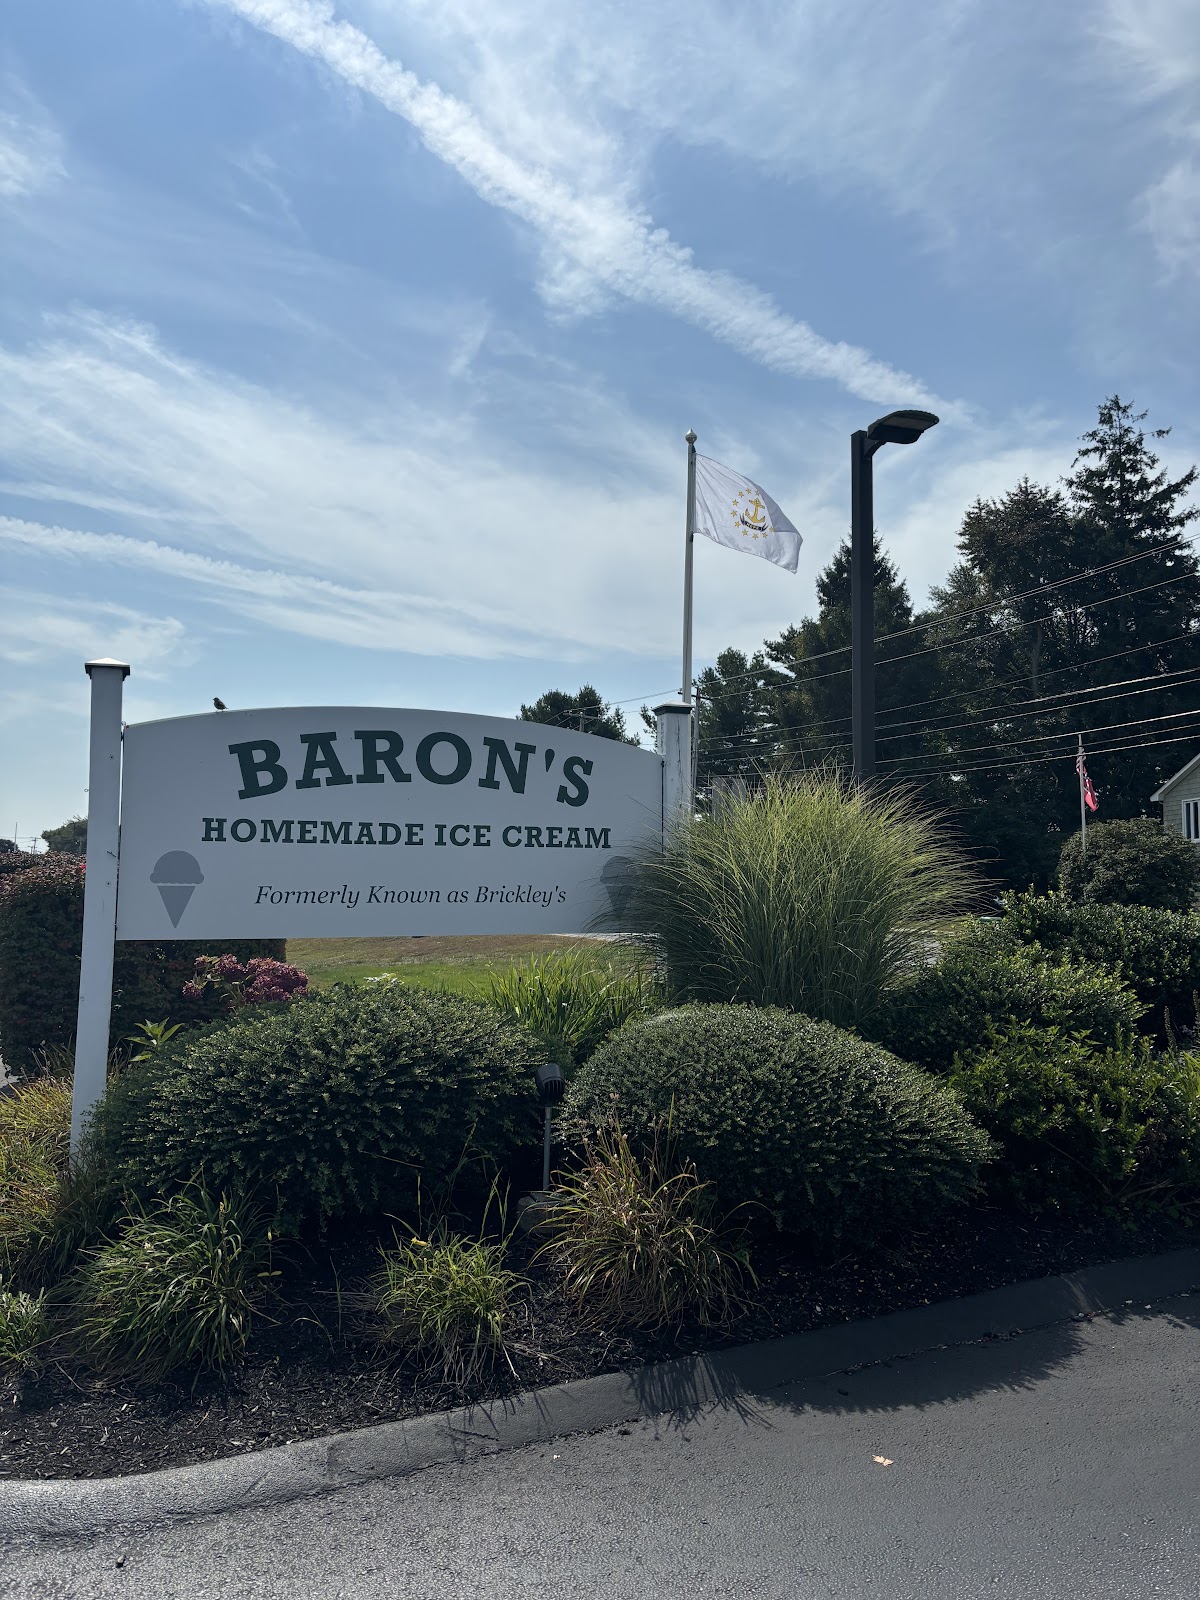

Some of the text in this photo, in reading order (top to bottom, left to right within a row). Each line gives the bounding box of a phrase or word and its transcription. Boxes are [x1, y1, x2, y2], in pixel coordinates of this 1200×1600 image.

[228, 730, 593, 807] BARON'S
[202, 818, 612, 849] HOMEMADE ICE CREAM
[254, 885, 566, 908] Formerly Known as Brickley's
